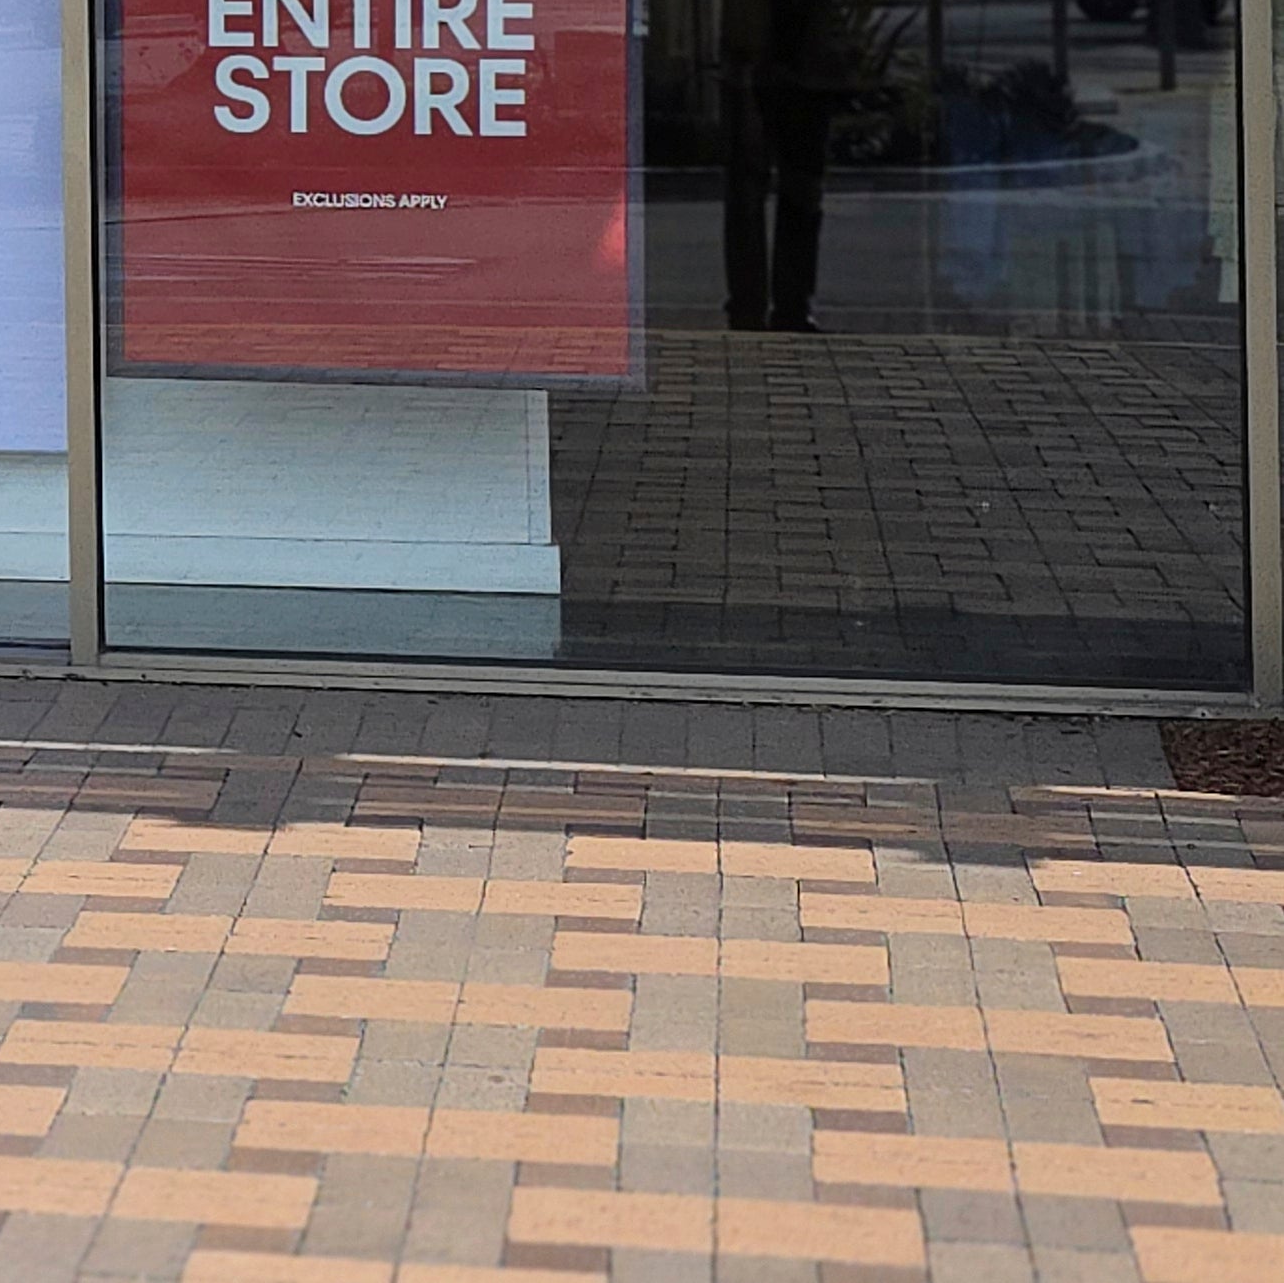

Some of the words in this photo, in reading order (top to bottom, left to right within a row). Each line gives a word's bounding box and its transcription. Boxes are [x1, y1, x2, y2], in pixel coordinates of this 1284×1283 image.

[214, 55, 529, 138] STORE
[292, 191, 396, 209] EXCLUSIONS
[398, 193, 448, 210] APPLY
